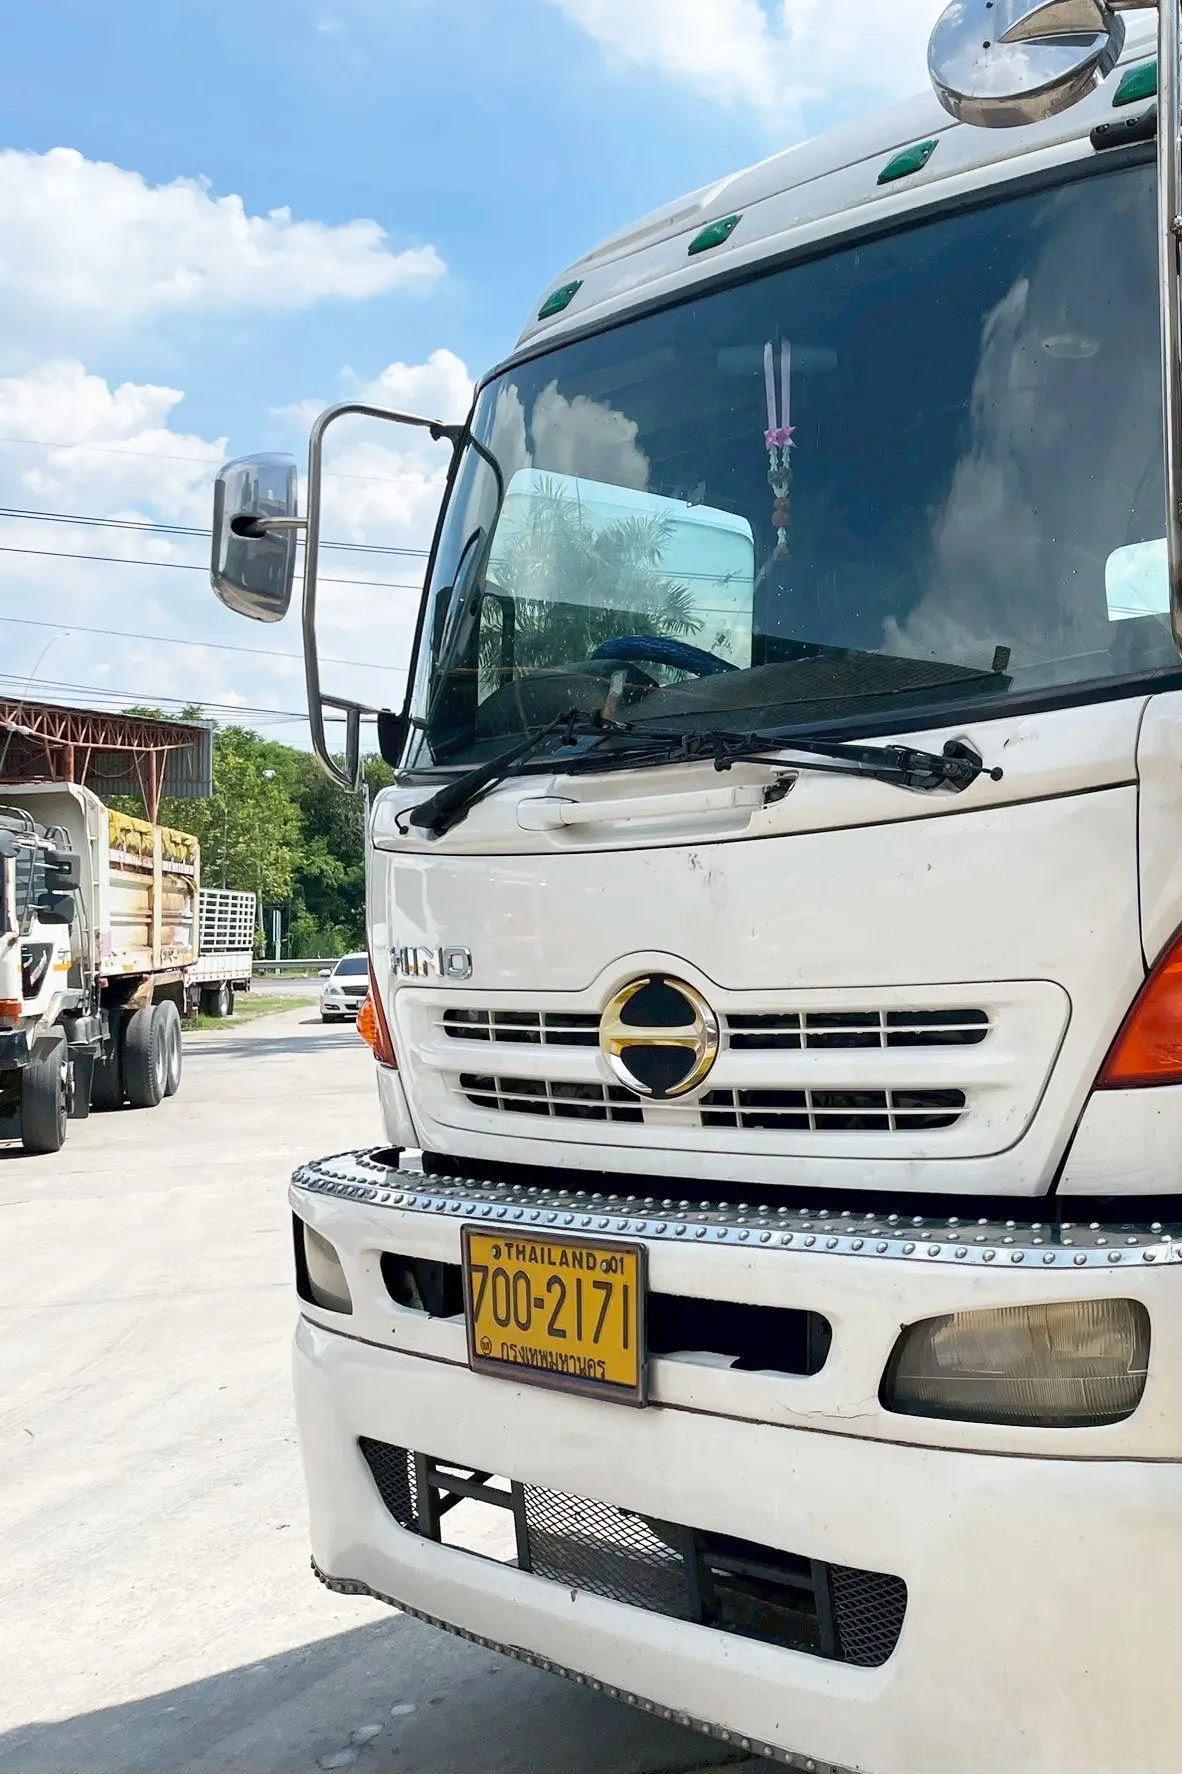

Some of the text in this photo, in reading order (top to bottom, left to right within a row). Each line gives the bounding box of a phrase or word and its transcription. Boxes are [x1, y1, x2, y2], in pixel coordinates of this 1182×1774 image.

[388, 945, 474, 981] HINO
[504, 1242, 598, 1271] THAILAND
[470, 1263, 629, 1350] 700-2171
[500, 1341, 606, 1380] กรงเทพมหานคร
